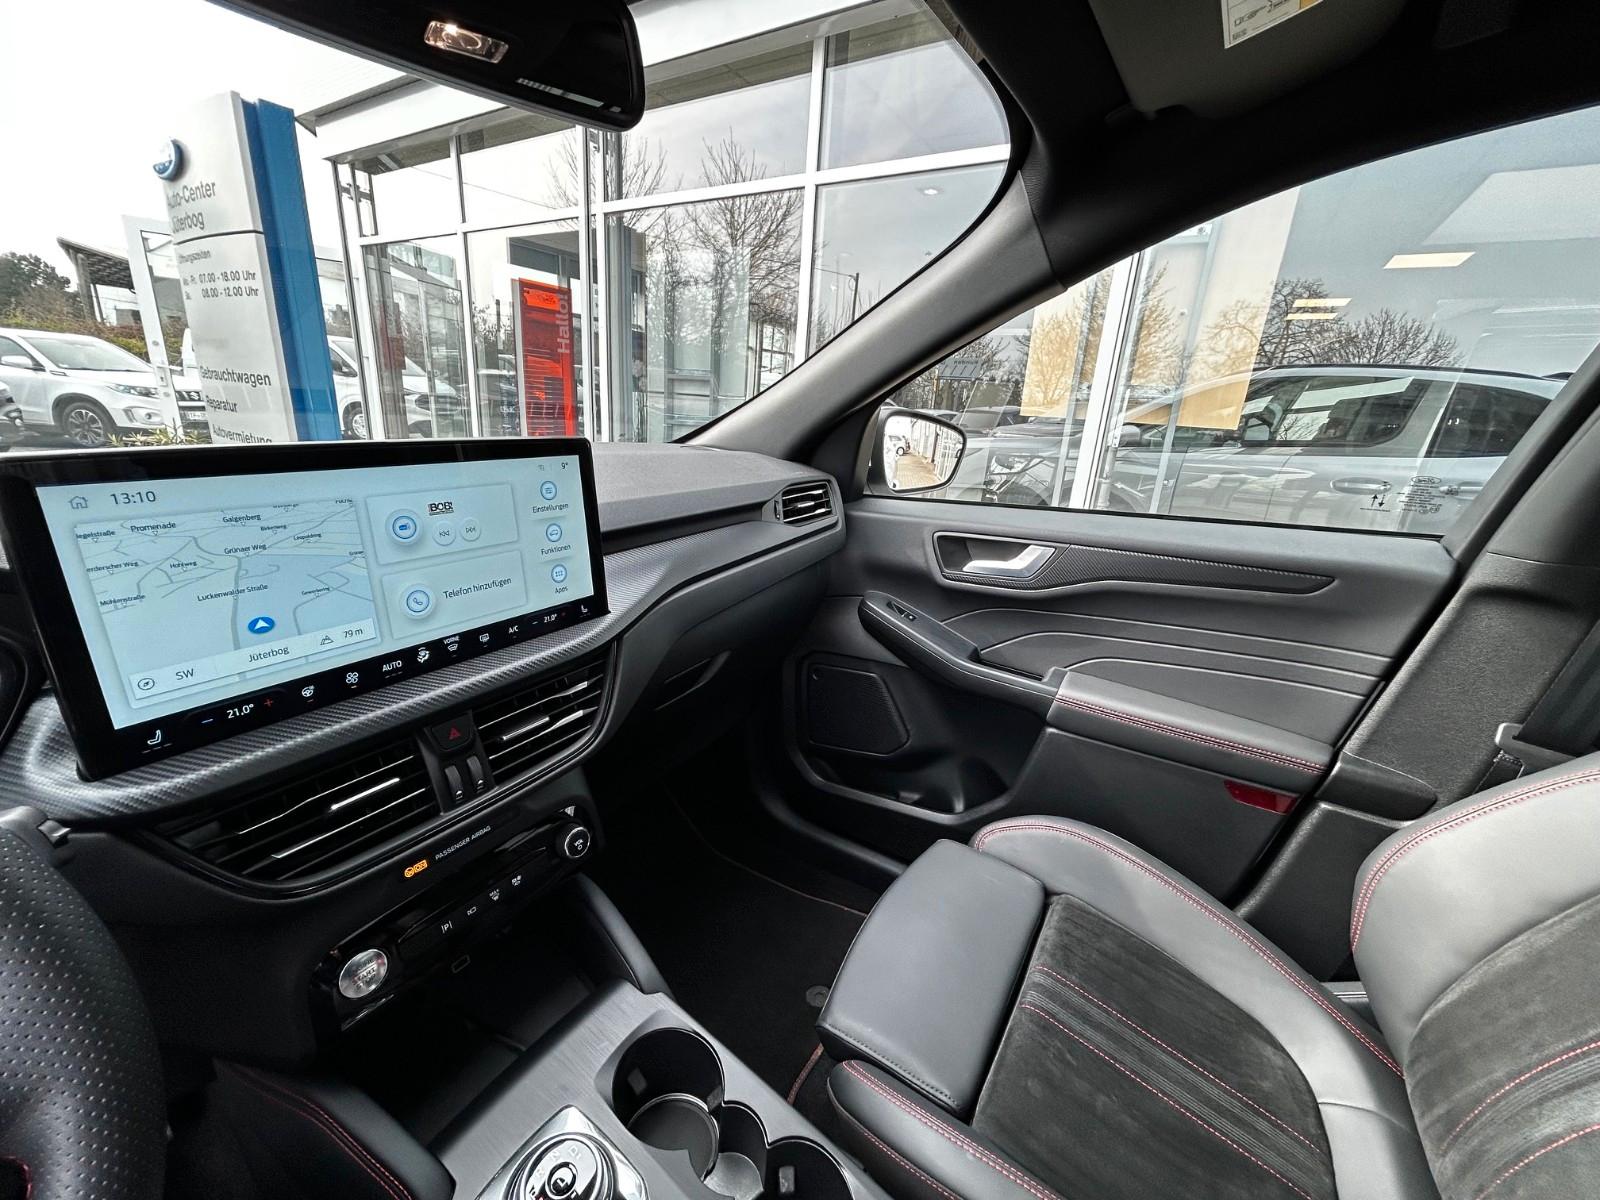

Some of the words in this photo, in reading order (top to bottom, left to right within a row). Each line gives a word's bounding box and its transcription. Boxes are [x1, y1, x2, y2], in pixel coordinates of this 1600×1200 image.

[221, 271, 240, 282] 18.00
[242, 271, 256, 280] Uhr
[224, 286, 243, 297] 12.00
[245, 286, 259, 296] Uhr
[556, 293, 570, 353] Hallo!
[199, 366, 272, 388] Gebrauchtwagen
[206, 396, 238, 413] Reparatur
[110, 491, 156, 505] 13:10
[532, 503, 569, 514] Einstellungen
[222, 513, 261, 523] Galgenberg
[130, 522, 177, 533] Promenade
[224, 546, 251, 555] Grünaer
[252, 543, 267, 551] Weg
[541, 545, 571, 556] Funktionen
[198, 588, 245, 602] Luckenwalder
[246, 584, 268, 594] Straße
[443, 585, 473, 600] Telefon
[474, 577, 512, 593] hinzufügen
[555, 586, 568, 595] Apps
[508, 625, 519, 633] A/C
[248, 646, 290, 663] Jüterbog
[382, 660, 402, 672] AUTO
[176, 668, 194, 680] SW
[227, 703, 254, 719] 21.0°
[434, 836, 470, 860] PASSENGER
[470, 825, 491, 840] AIRBAG
